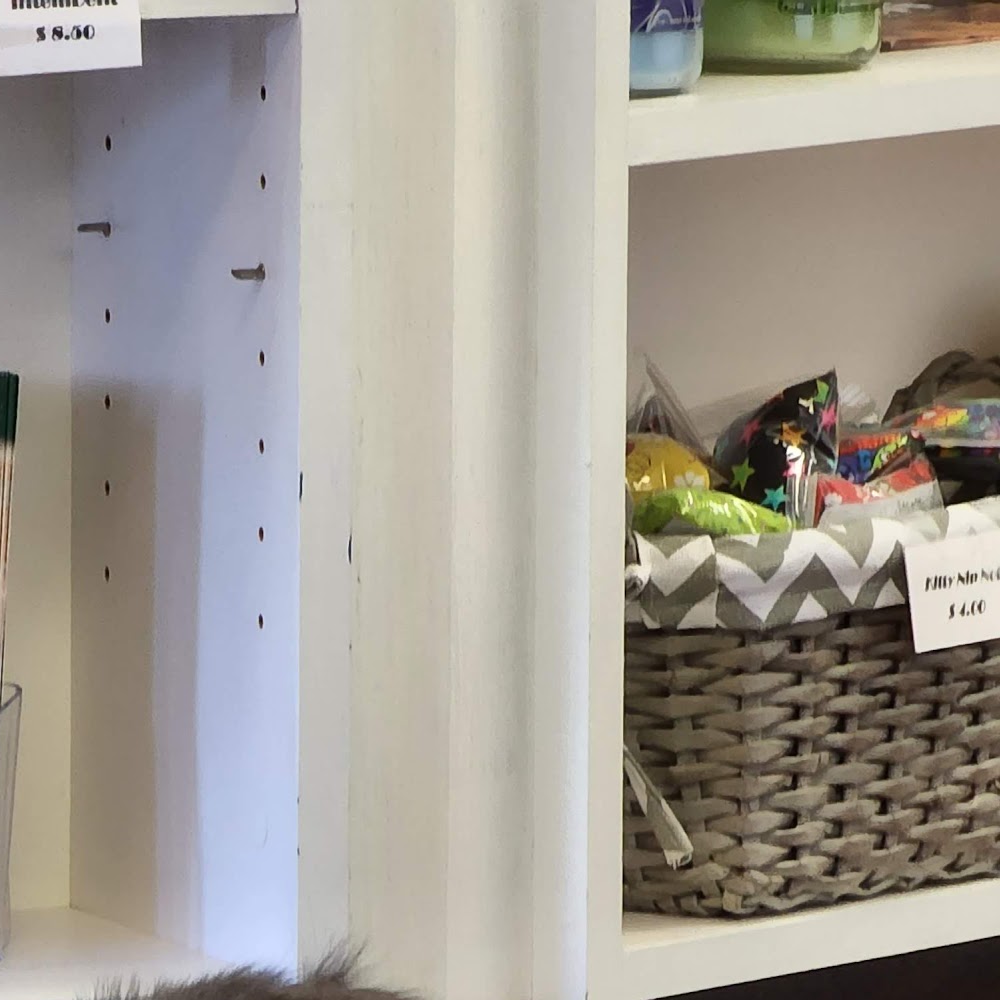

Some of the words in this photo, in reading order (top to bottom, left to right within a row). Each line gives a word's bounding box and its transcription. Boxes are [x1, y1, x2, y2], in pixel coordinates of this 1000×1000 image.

[36, 26, 47, 42] $
[51, 24, 96, 42] 8.50
[948, 602, 956, 620] $
[959, 599, 986, 618] 4.00
